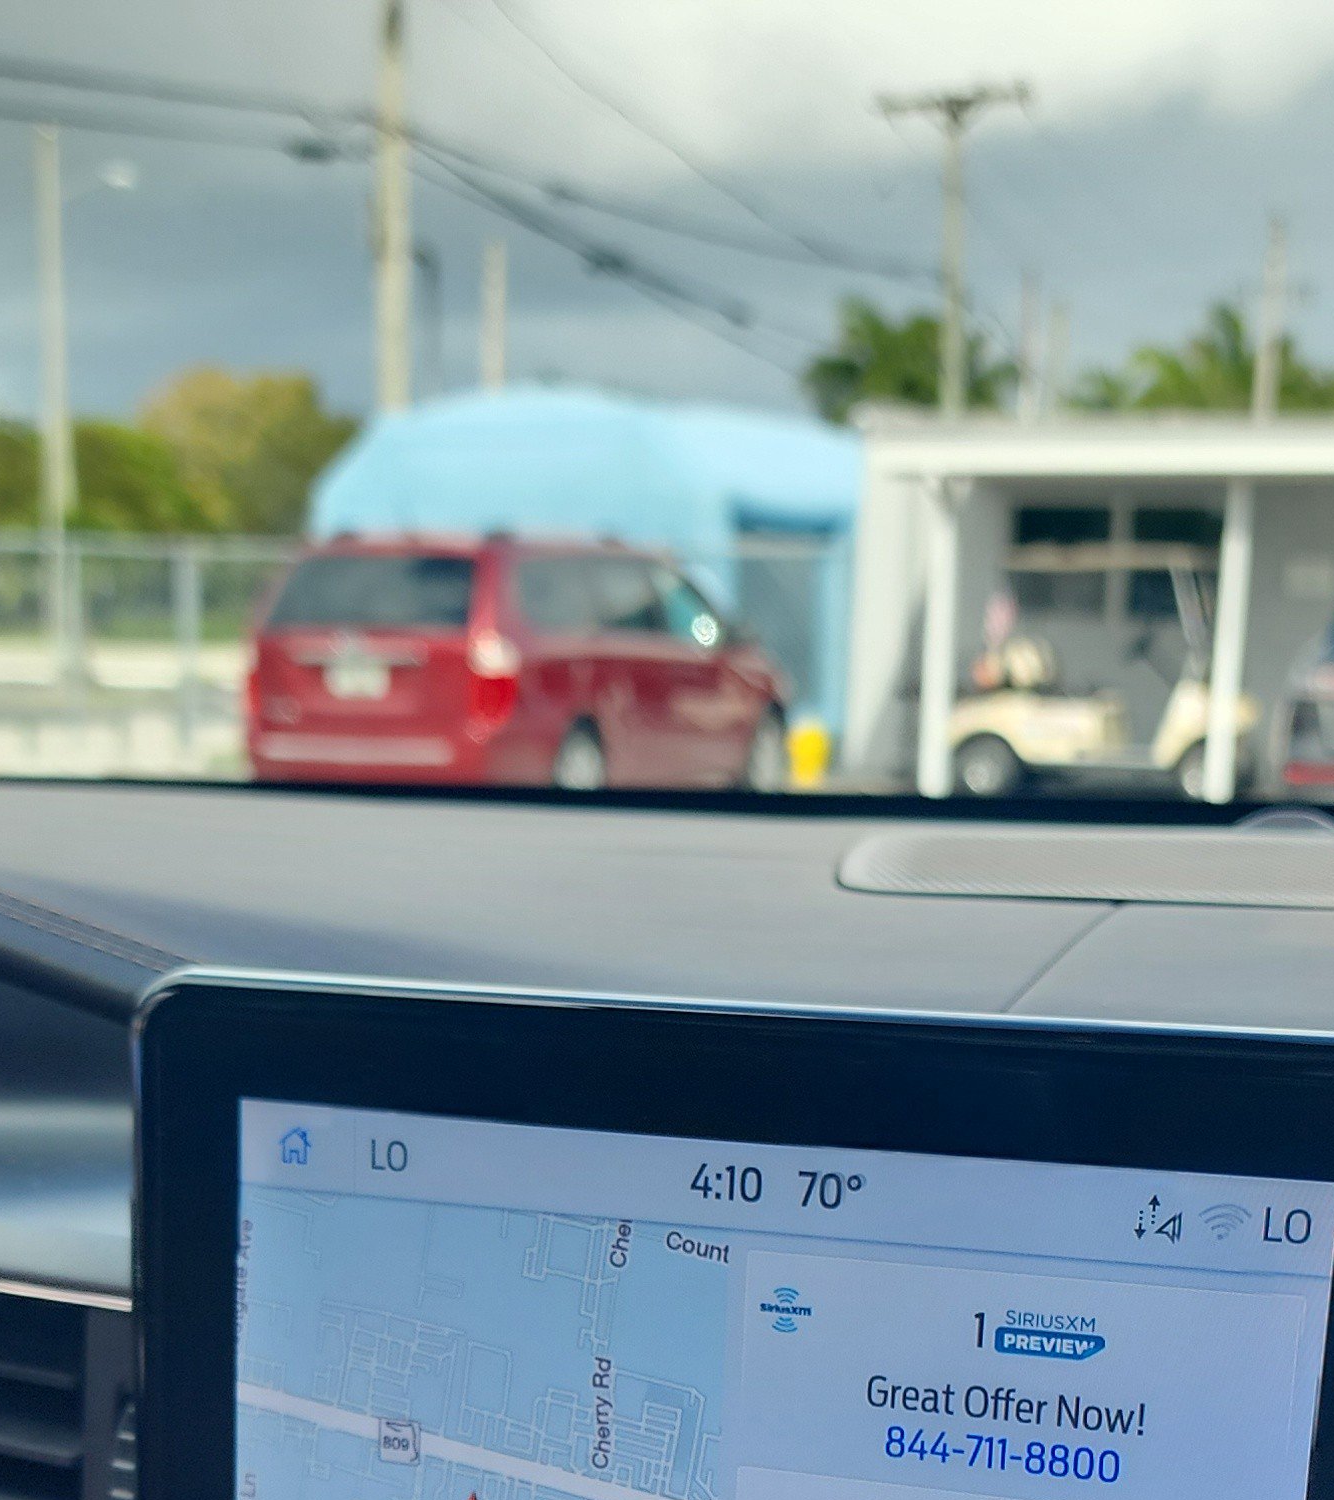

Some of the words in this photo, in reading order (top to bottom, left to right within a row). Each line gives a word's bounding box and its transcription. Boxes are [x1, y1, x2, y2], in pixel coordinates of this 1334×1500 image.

[371, 1139, 408, 1172] LO
[690, 1163, 763, 1203] 4:10
[798, 1170, 865, 1210] 70°
[1262, 1206, 1312, 1245] LO
[666, 1230, 730, 1264] Count
[974, 1311, 986, 1349] 1
[1004, 1309, 1098, 1333] SIRIUSXM
[1002, 1332, 1096, 1357] PREVIEW
[592, 1356, 612, 1390] Rd
[866, 1375, 956, 1418] Great
[964, 1384, 1048, 1426] Offer
[1056, 1394, 1147, 1437] Now!
[382, 1434, 410, 1452] 809
[591, 1396, 614, 1470] Cherry
[884, 1425, 1121, 1483] 844-711-8800
